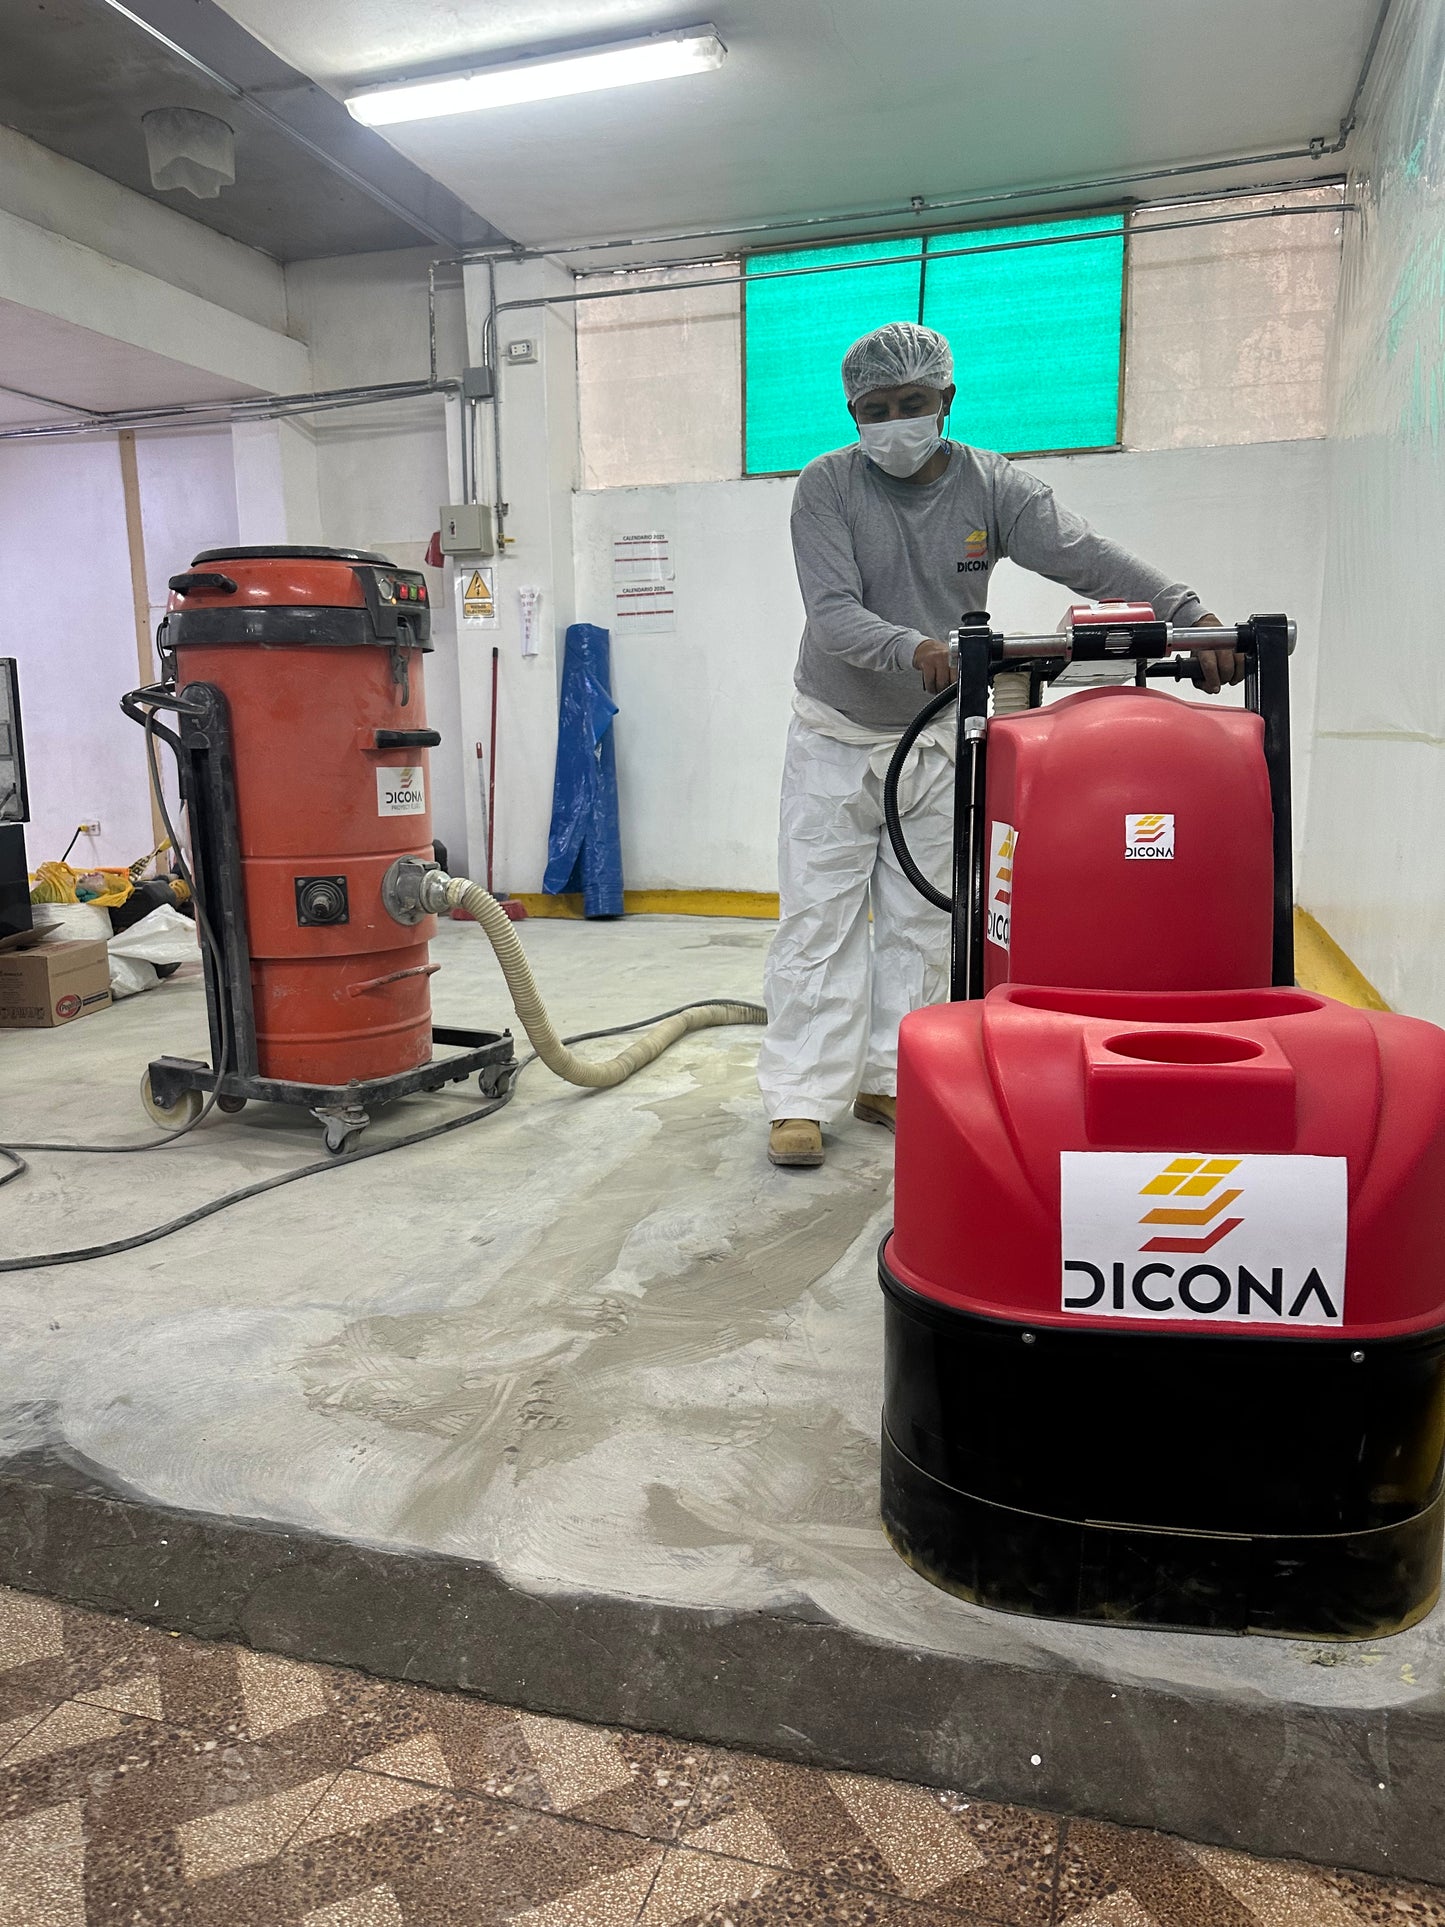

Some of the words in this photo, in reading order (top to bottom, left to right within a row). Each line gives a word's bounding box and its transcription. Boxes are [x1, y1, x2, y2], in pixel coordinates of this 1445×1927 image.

[386, 791, 422, 803] DICONA
[1125, 847, 1174, 857] DICONA
[1064, 1260, 1338, 1317] DICONA
